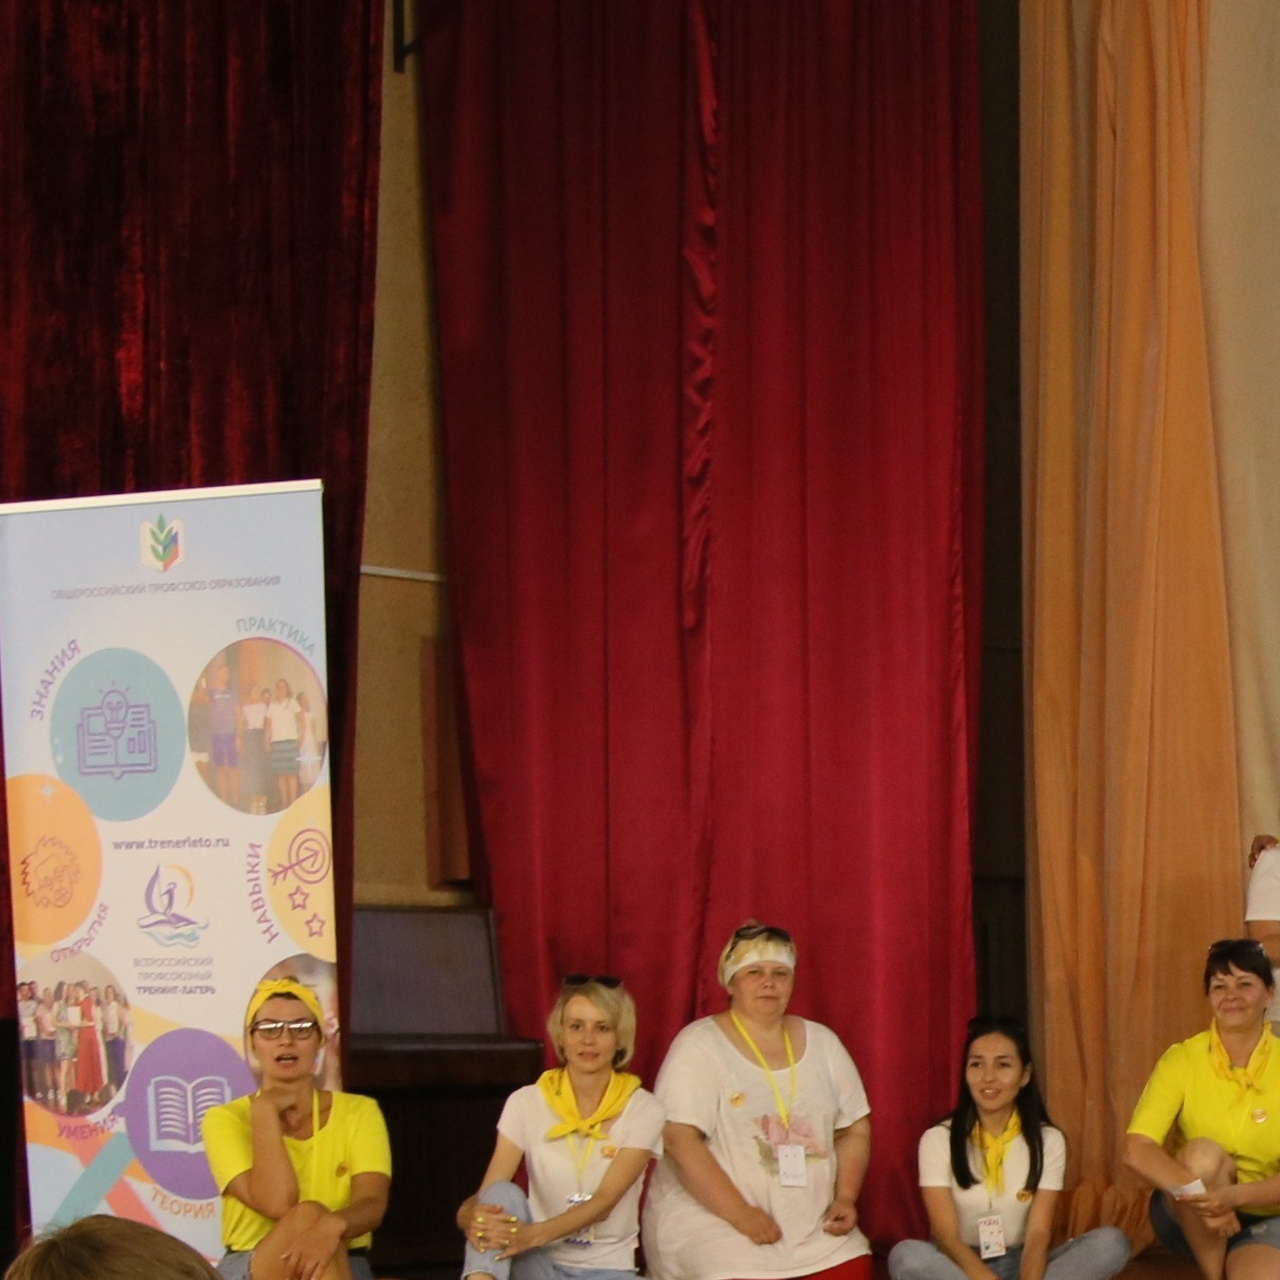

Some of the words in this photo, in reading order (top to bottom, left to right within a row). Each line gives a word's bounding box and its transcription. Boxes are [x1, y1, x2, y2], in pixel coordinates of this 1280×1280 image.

[208, 575, 282, 591] ОБРАЗОВАНИЯ
[236, 616, 315, 657] ПРАКТИКА
[30, 639, 81, 721] ЗНАНИЯ
[112, 836, 230, 850] www.trenerleto.ru
[246, 843, 280, 944] НАВЫКИ
[50, 902, 109, 963] ОТКРЫТИЯ
[136, 985, 216, 995] ТРЕНИНГ-ЛАГЕРЬ
[58, 1114, 119, 1139] УМЕНИЯ
[152, 1187, 216, 1219] ТЕОРИЯ
